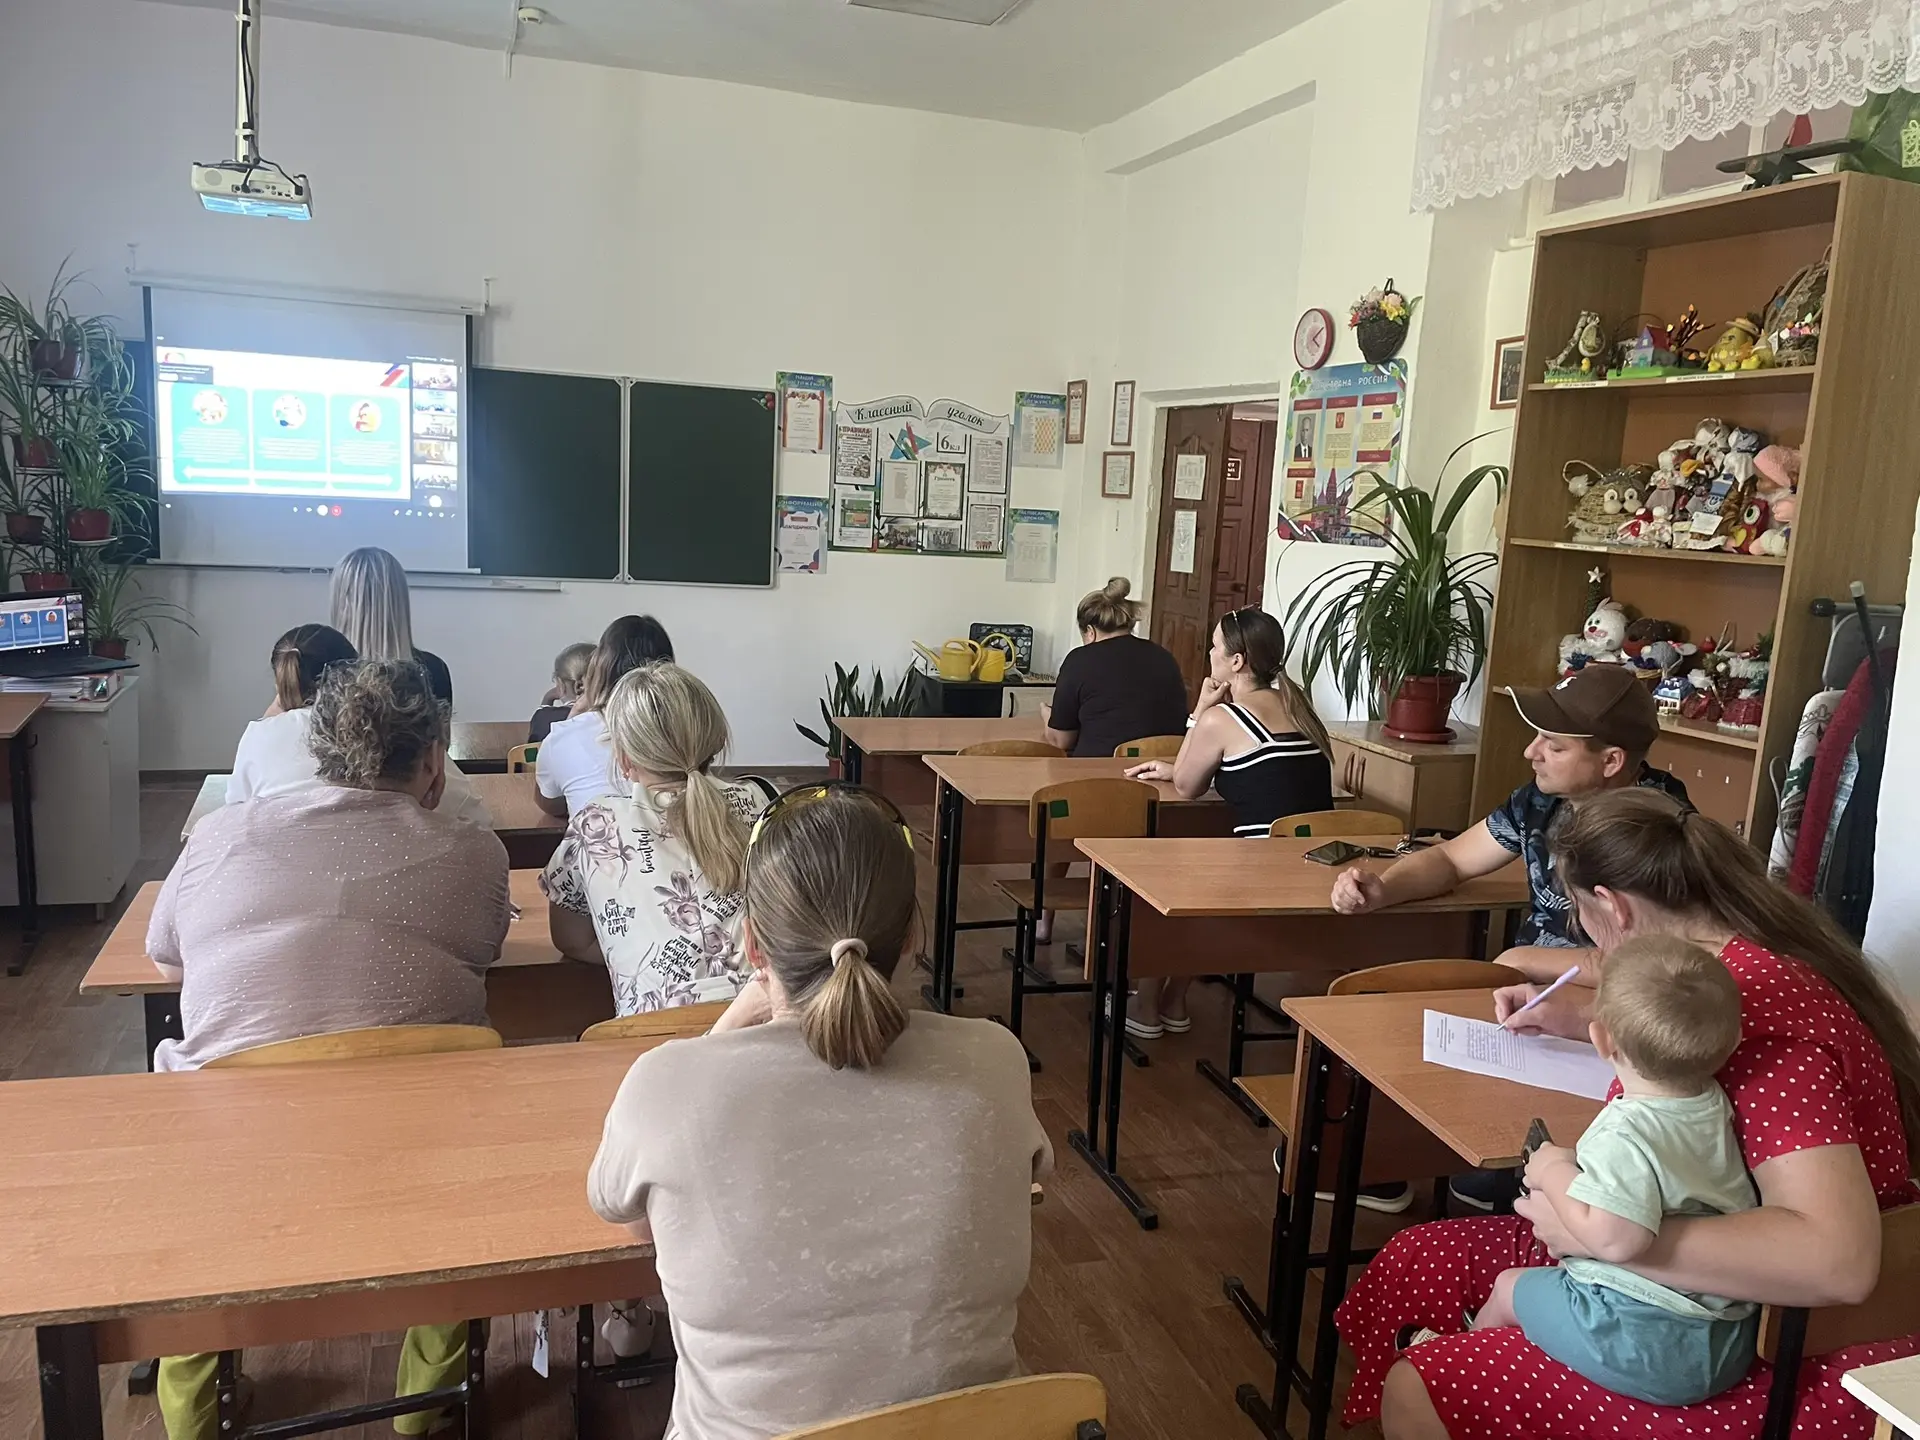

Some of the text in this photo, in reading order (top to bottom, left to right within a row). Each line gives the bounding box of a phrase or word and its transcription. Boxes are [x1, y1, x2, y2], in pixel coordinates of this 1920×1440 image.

[1358, 375, 1388, 385] РОССИЯ
[855, 401, 985, 426] Классный уголок
[631, 827, 655, 873] beautiful
[605, 902, 624, 919] best
[608, 923, 629, 938] come
[664, 939, 702, 970] beautiful
